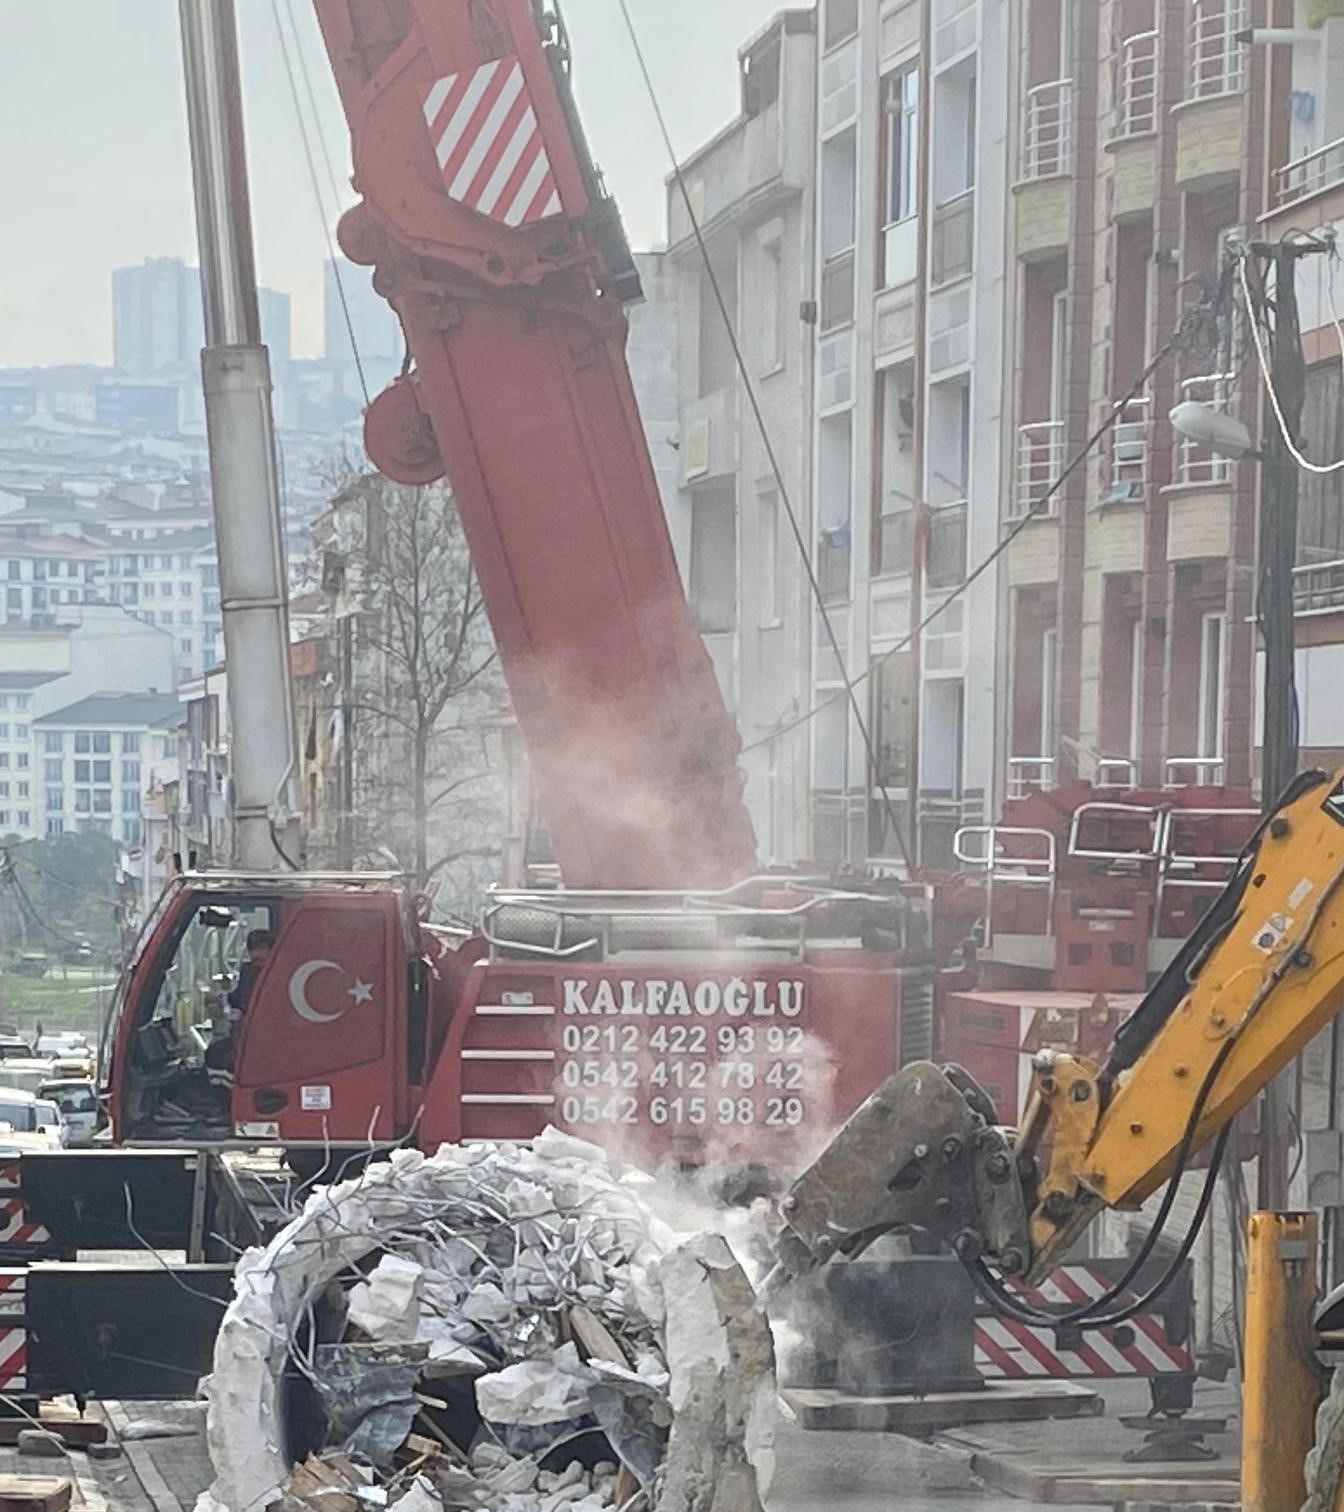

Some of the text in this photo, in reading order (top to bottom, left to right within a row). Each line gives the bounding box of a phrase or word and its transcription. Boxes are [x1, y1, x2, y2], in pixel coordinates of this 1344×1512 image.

[562, 976, 805, 1017] KALFAOĞLU
[562, 1025, 805, 1054] 0212 422 93 92
[562, 1060, 804, 1090] 0542 412 78 42
[562, 1096, 804, 1126] 0542 615 98 29
